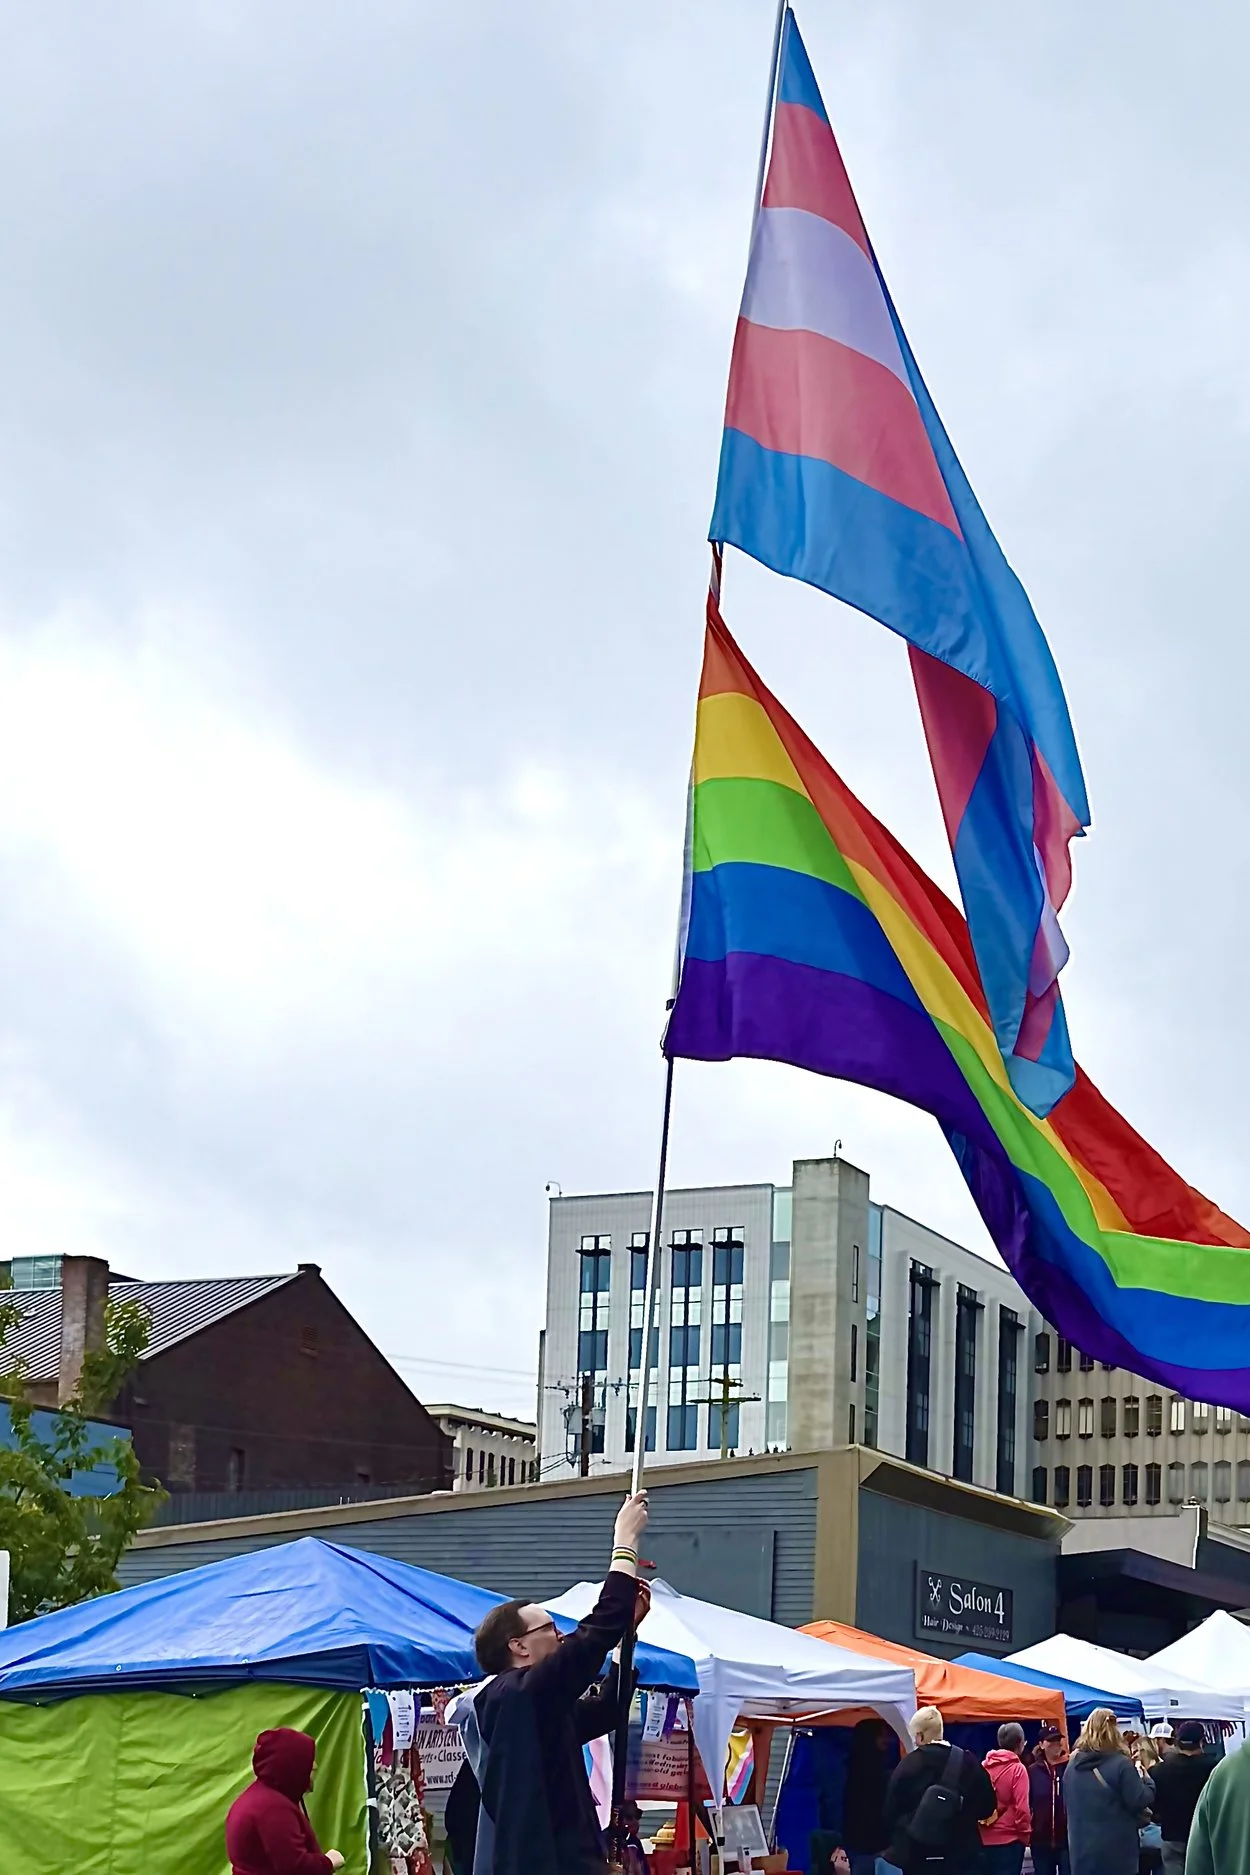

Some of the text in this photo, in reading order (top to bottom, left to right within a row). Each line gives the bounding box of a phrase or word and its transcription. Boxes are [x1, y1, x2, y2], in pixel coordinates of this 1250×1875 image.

[949, 1582, 1005, 1624] Salon 4
[922, 1614, 939, 1627] Hair
[942, 1618, 963, 1634] Design
